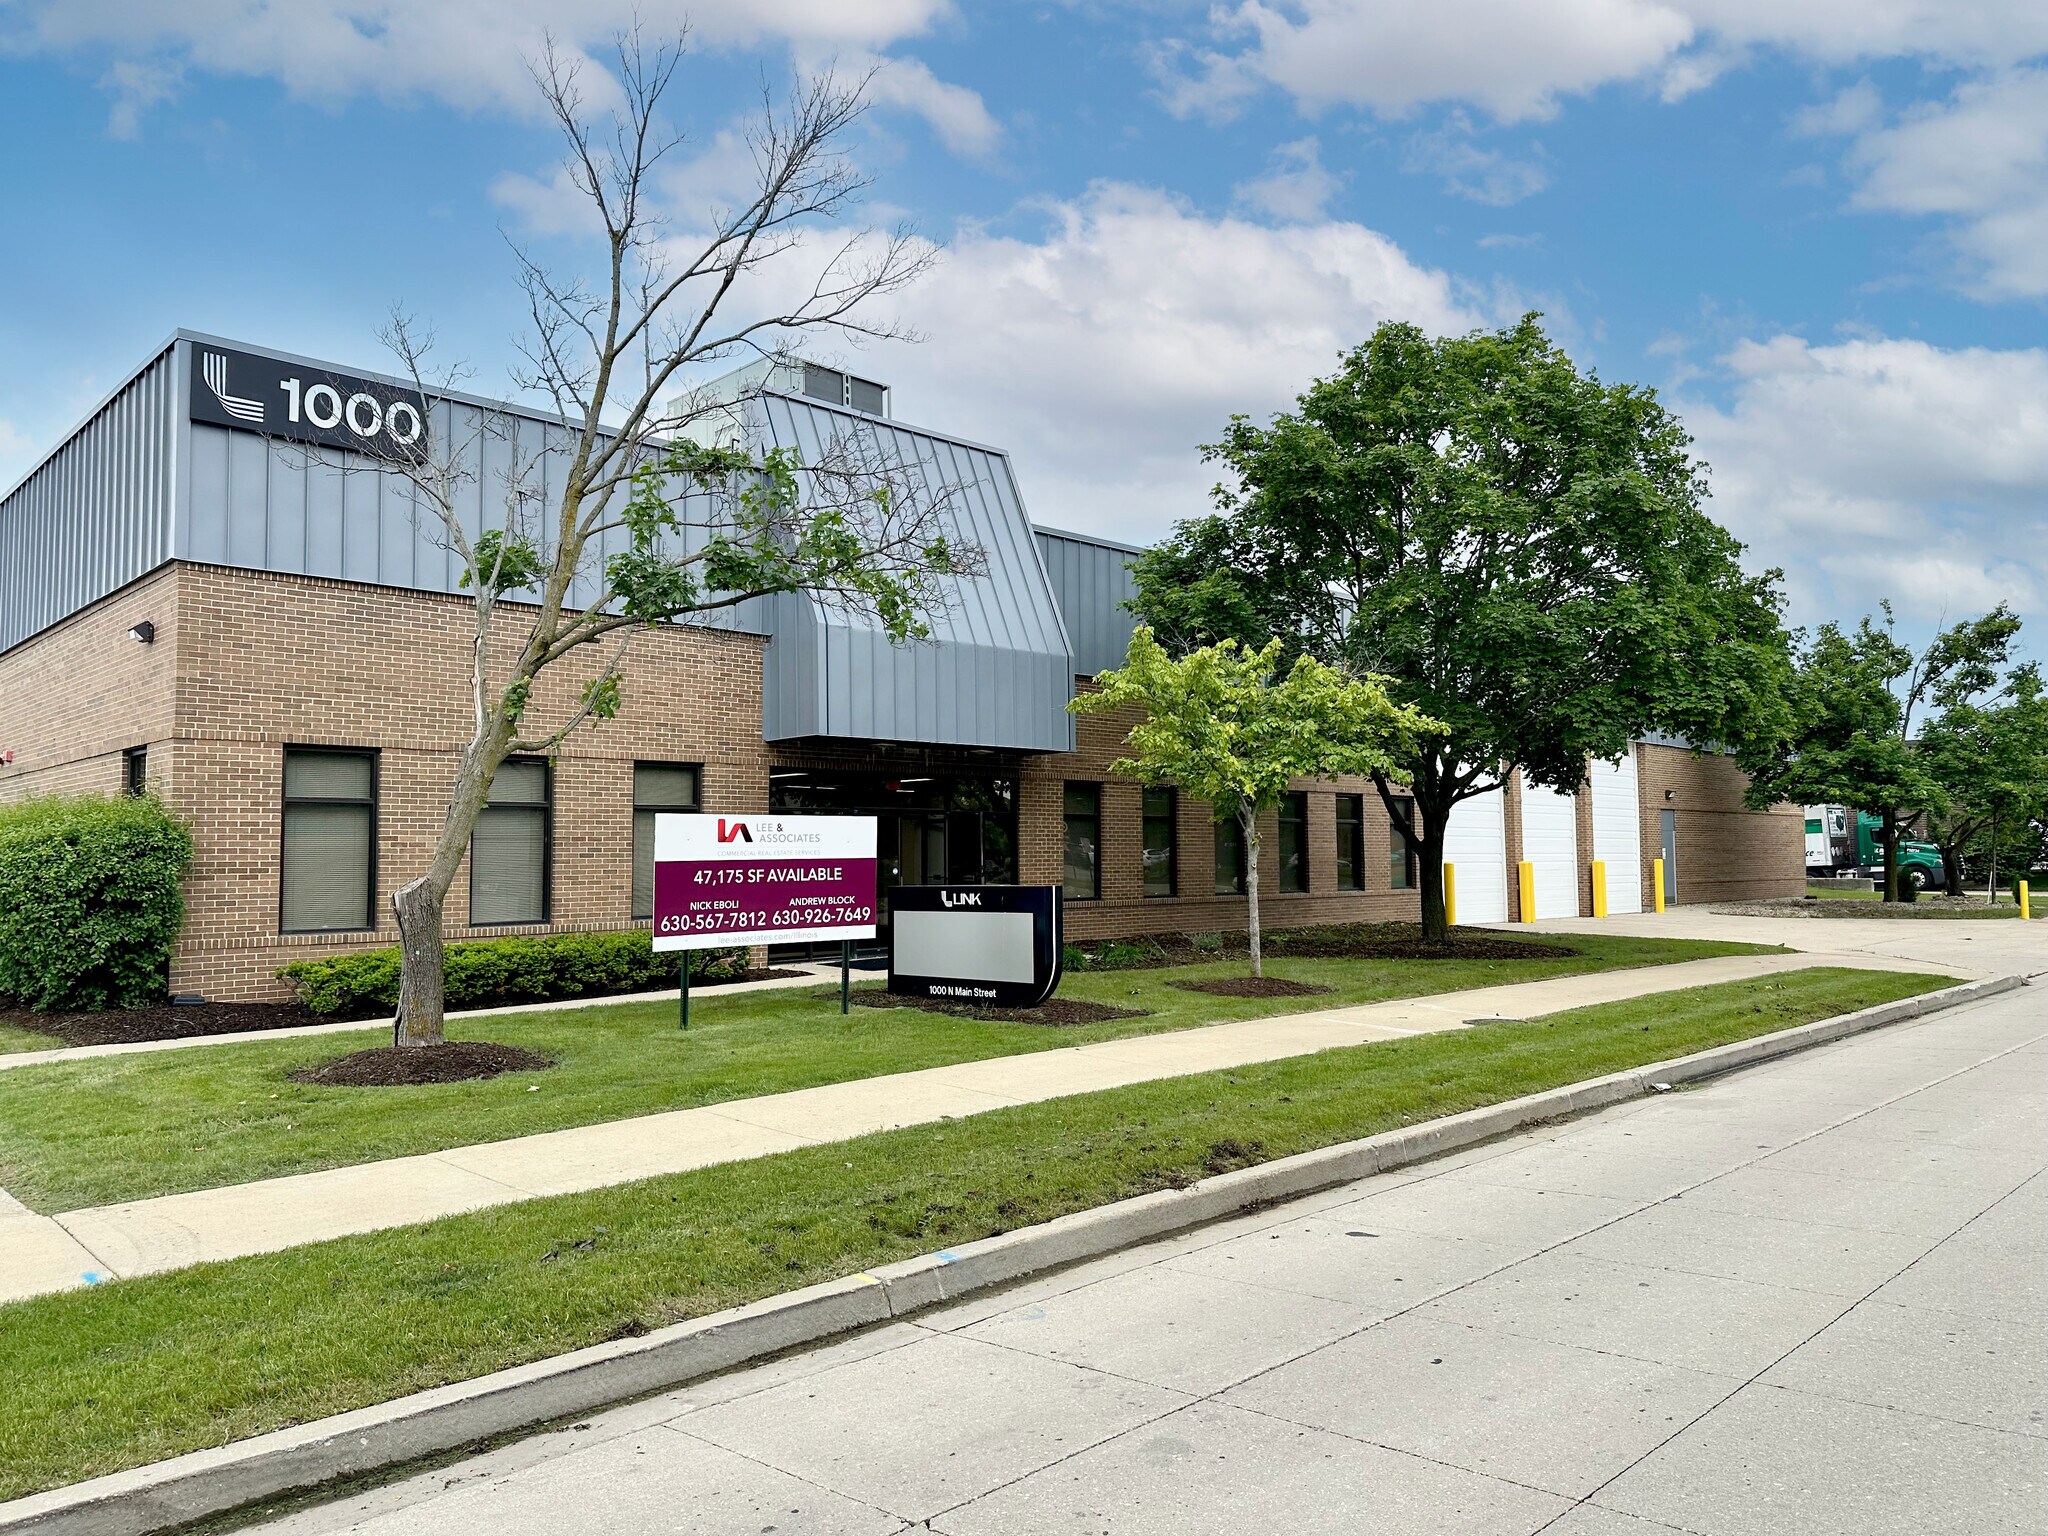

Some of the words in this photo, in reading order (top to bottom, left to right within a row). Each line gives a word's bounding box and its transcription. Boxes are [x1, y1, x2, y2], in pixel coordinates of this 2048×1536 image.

[280, 377, 421, 445] 1000
[756, 823, 773, 832] LEE
[776, 822, 784, 832] &
[759, 833, 821, 843] ASSOCIATES
[693, 869, 744, 886] 47,175
[747, 868, 765, 883] SF
[767, 867, 843, 882] AVAILABLE
[690, 901, 712, 911] NICK
[713, 900, 739, 910] EBOLI
[789, 897, 826, 907] ANDREW
[828, 895, 855, 905] BLOCK
[953, 893, 982, 906] LINK
[660, 911, 766, 932] 630-567-7812
[772, 906, 871, 926] 630-926-7649
[929, 985, 947, 995] 1000
[947, 986, 954, 996] N
[955, 987, 973, 996] Main
[973, 988, 997, 998] Street
